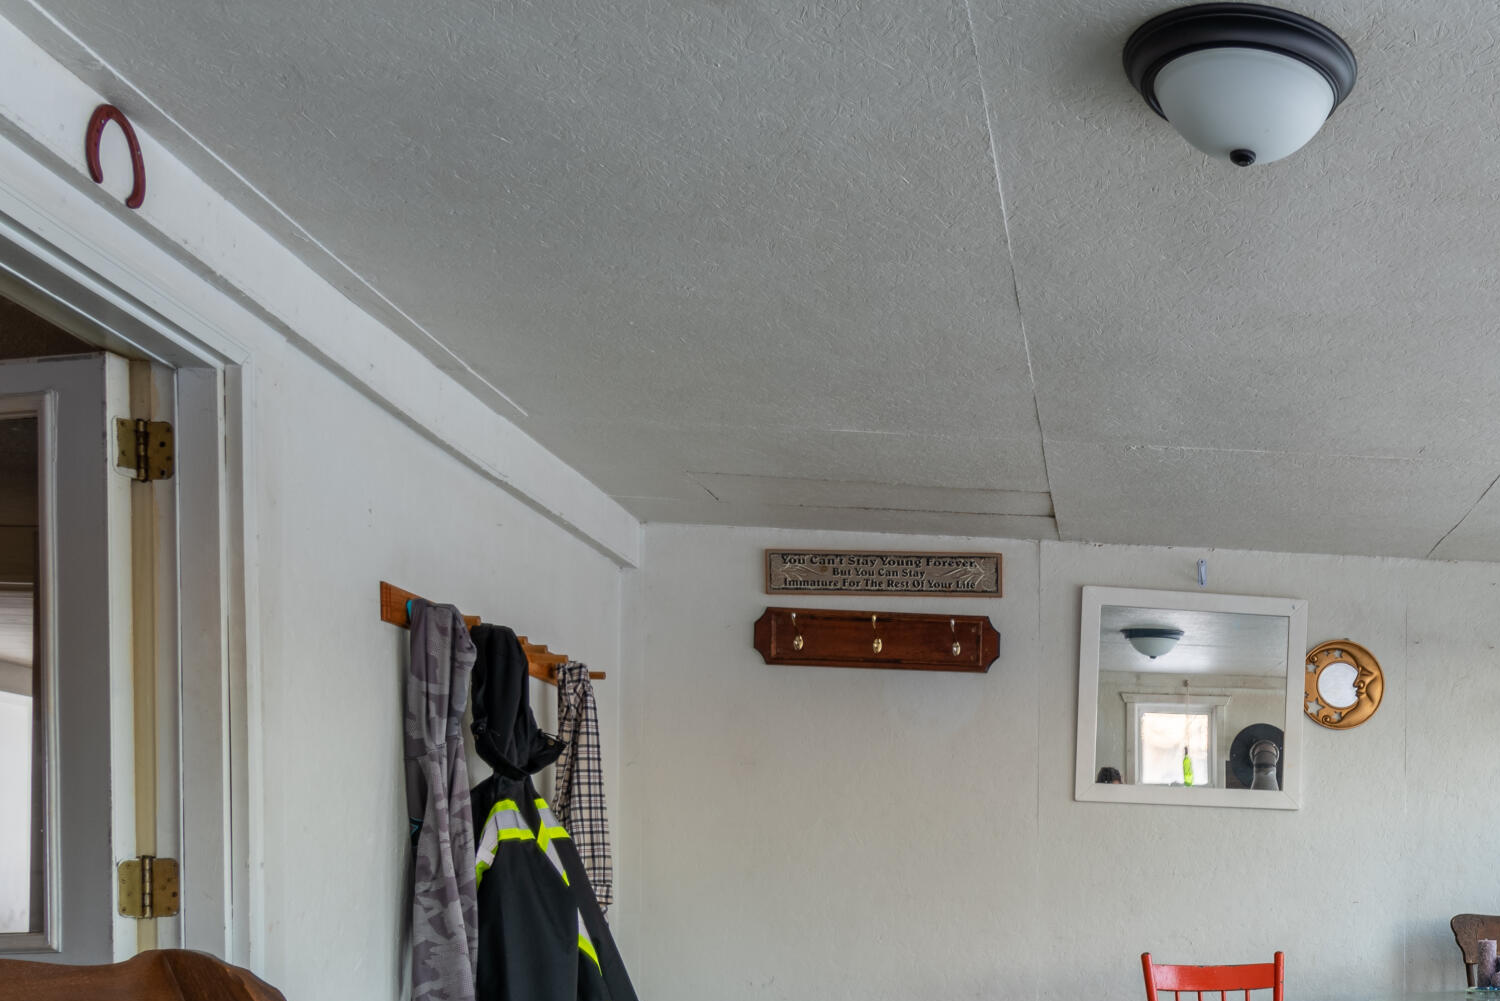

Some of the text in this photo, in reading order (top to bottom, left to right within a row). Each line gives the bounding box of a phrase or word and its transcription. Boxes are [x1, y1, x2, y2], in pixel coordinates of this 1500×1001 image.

[781, 554, 806, 565] You
[810, 555, 844, 565] Can't
[848, 556, 878, 568] Stay
[880, 557, 922, 569] Young
[832, 567, 926, 580] But You Can Stay
[783, 578, 977, 590] Immature For The Rest Of Your Life
